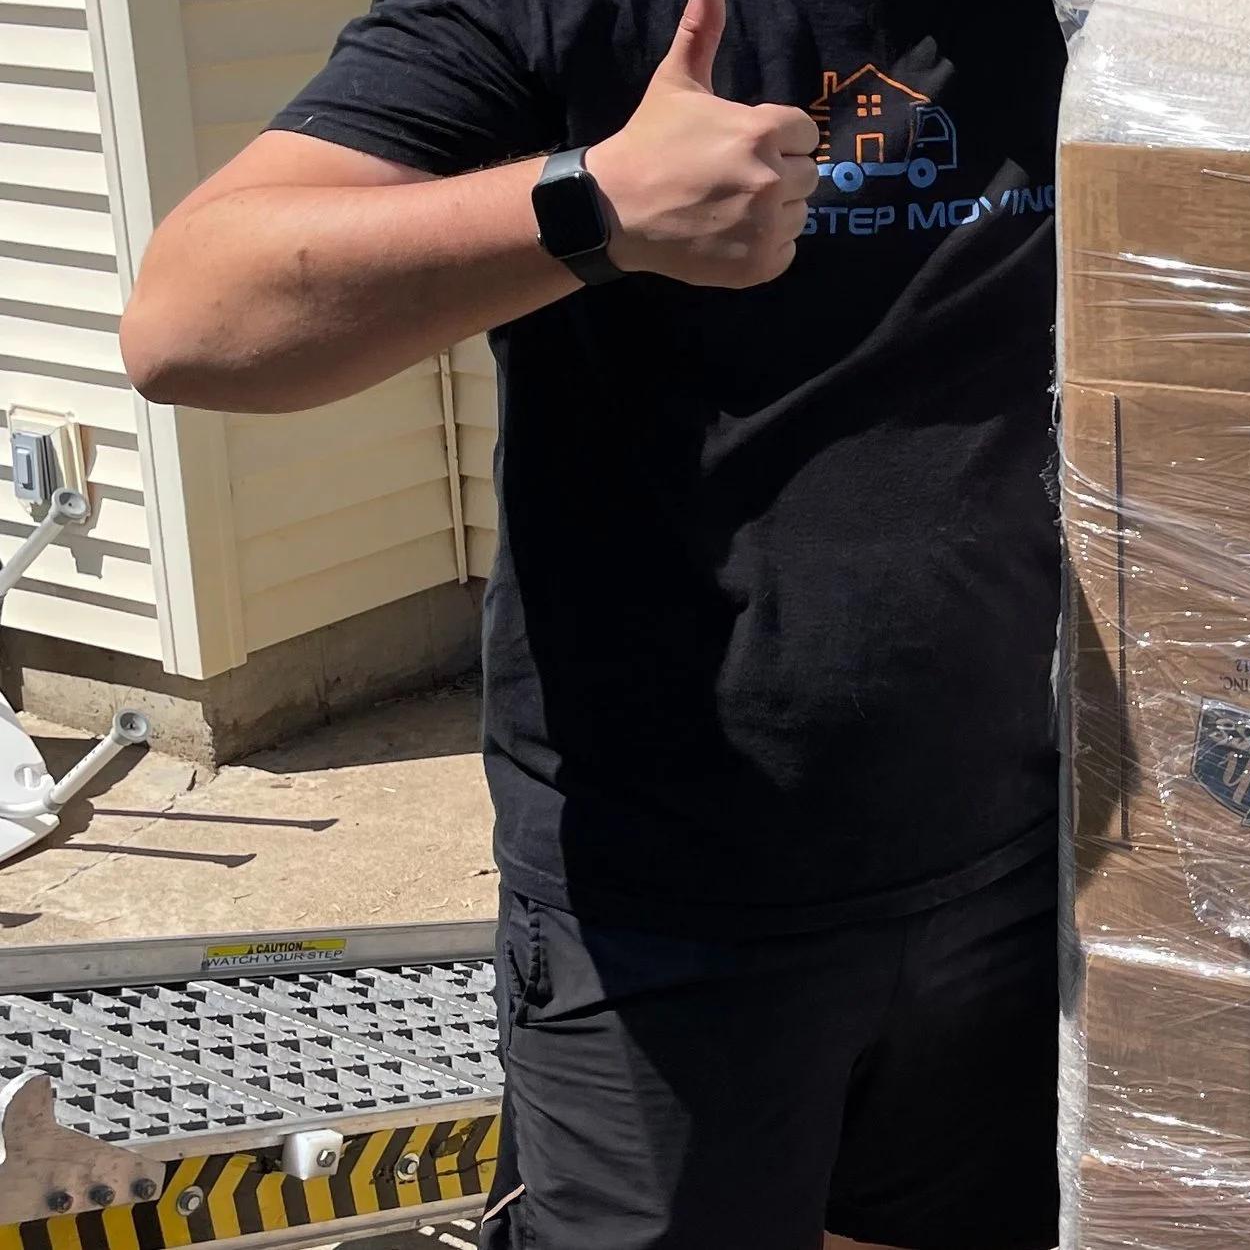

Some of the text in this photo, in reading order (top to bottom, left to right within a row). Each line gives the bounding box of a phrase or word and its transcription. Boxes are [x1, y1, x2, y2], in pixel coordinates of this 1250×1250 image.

[801, 206, 895, 236] STEP
[1219, 676, 1250, 693] INC.
[256, 942, 303, 954] CAUTION
[207, 950, 343, 967] WATCH YOUR STEP
